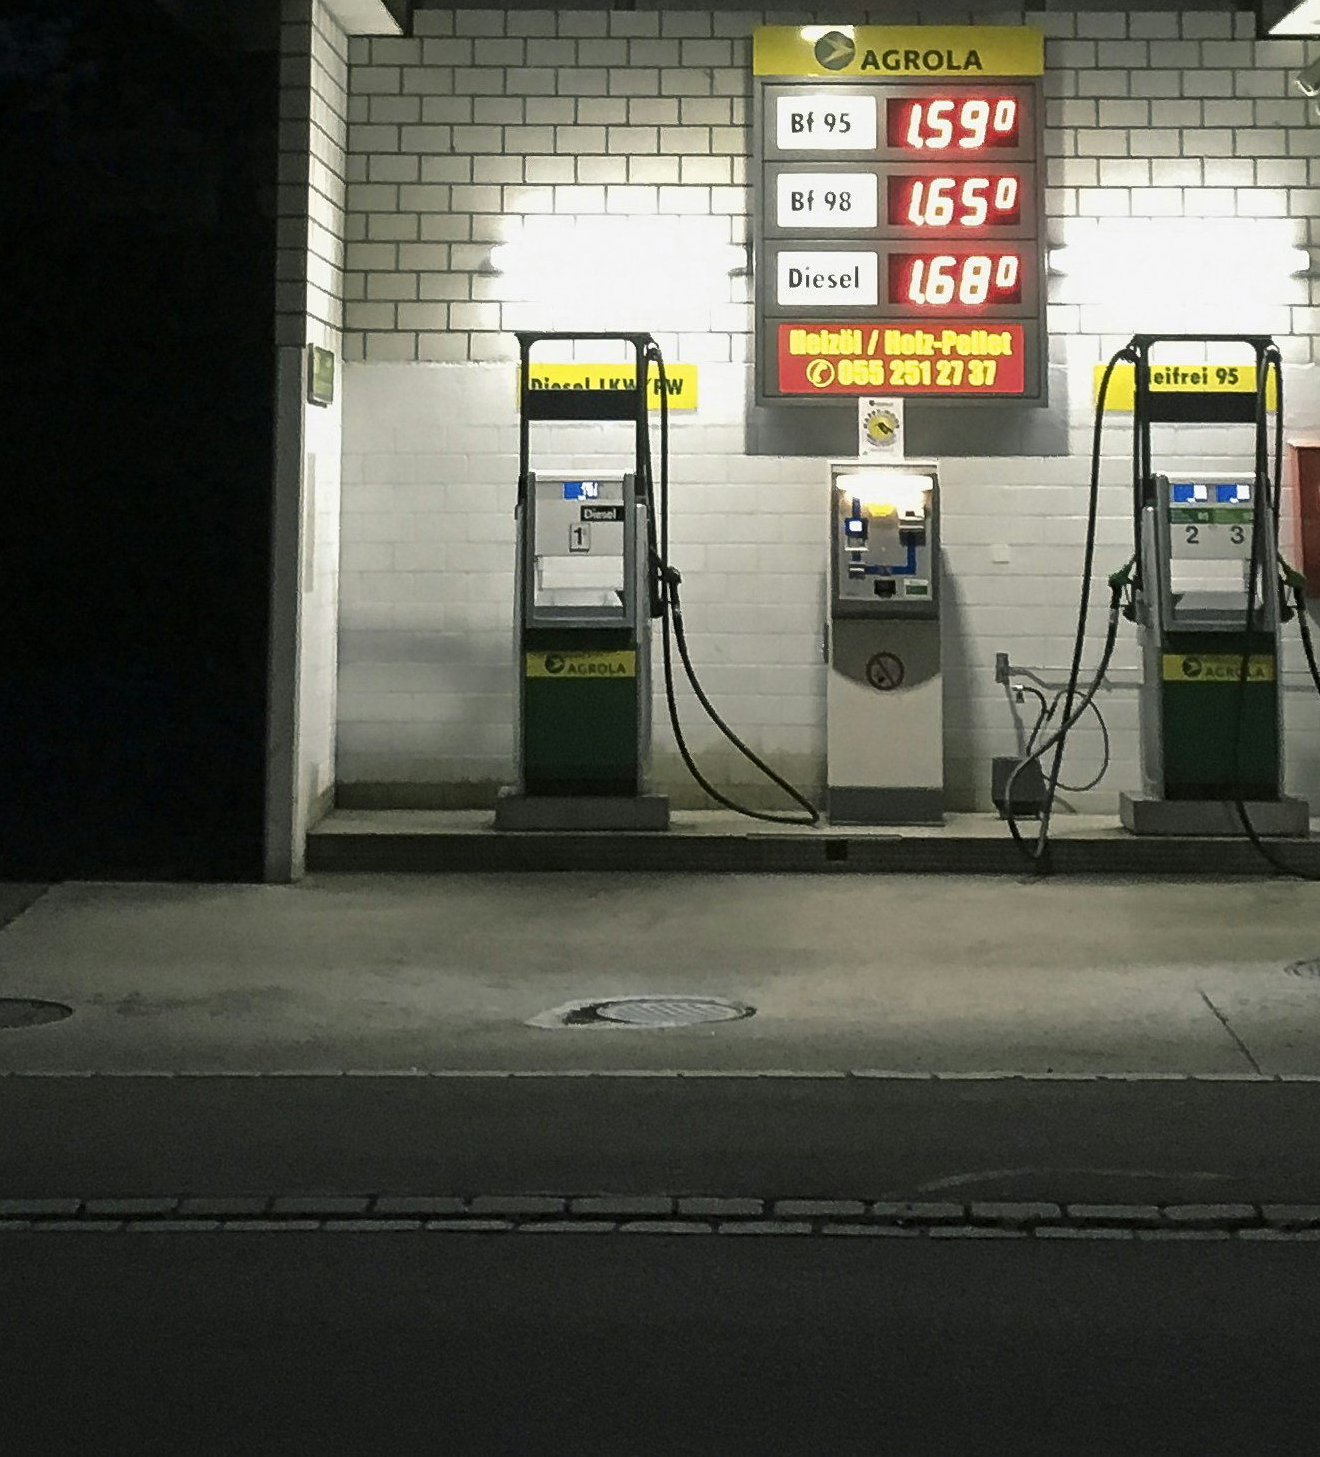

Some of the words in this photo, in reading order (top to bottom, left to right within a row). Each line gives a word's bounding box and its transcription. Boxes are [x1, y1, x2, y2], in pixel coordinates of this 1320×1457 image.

[860, 49, 983, 71] AGROLA
[791, 112, 813, 134] Bf
[824, 112, 851, 134] 95
[791, 190, 813, 212] Bf
[824, 191, 852, 212] 98
[788, 265, 860, 290] Diesel
[789, 329, 863, 356] Heizöl
[867, 329, 879, 356] /
[884, 329, 1013, 356] Holz-Pellet
[837, 359, 885, 387] 055
[889, 359, 932, 386] 251
[936, 359, 964, 386] 27
[968, 359, 997, 386] 37
[1216, 368, 1239, 385] 95
[573, 526, 583, 546] 1
[1186, 525, 1200, 545] 2
[1230, 525, 1246, 545] 3
